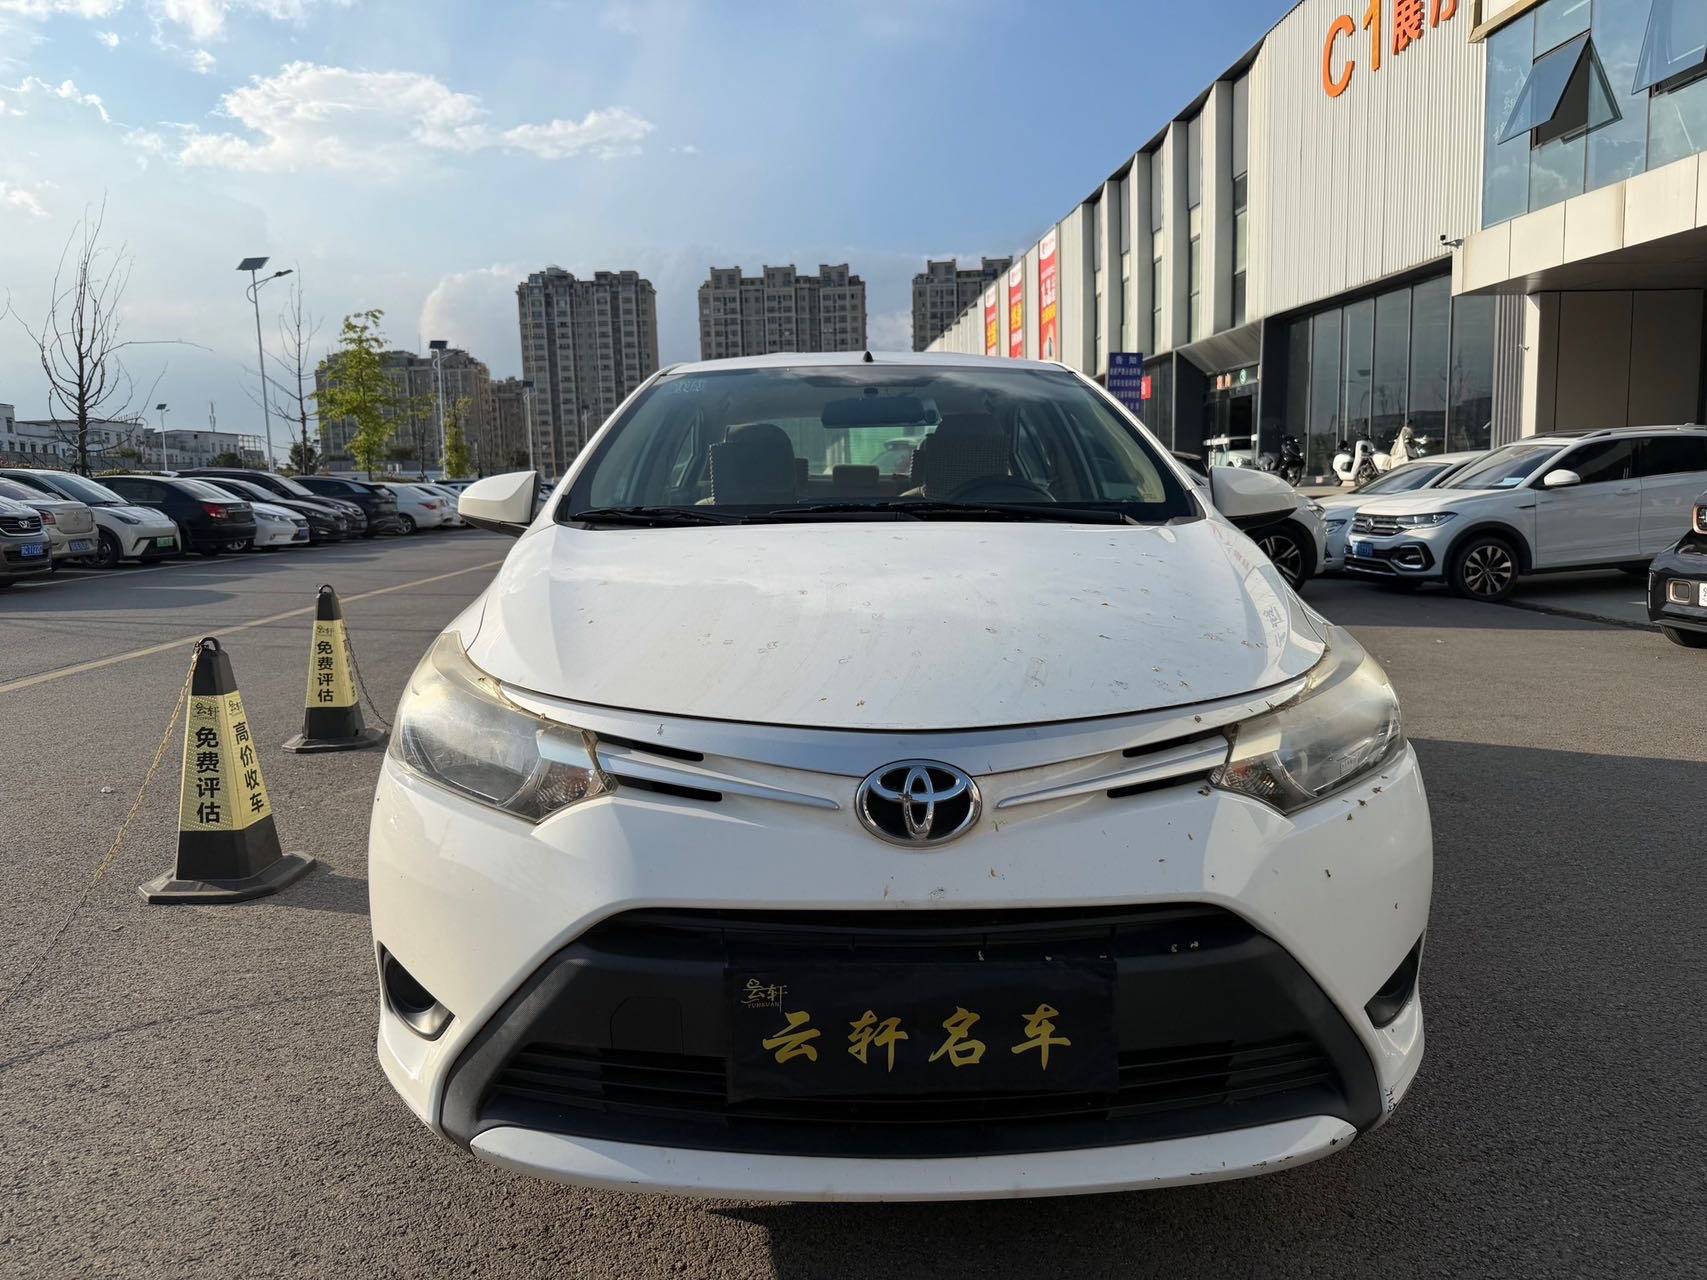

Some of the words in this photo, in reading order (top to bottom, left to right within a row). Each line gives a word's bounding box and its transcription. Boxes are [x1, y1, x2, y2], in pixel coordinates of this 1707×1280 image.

[317, 641, 334, 703] 免费评估
[195, 726, 221, 824] 免费评估
[232, 721, 264, 814] 高价收车
[762, 1003, 1072, 1072] 云轩名车
